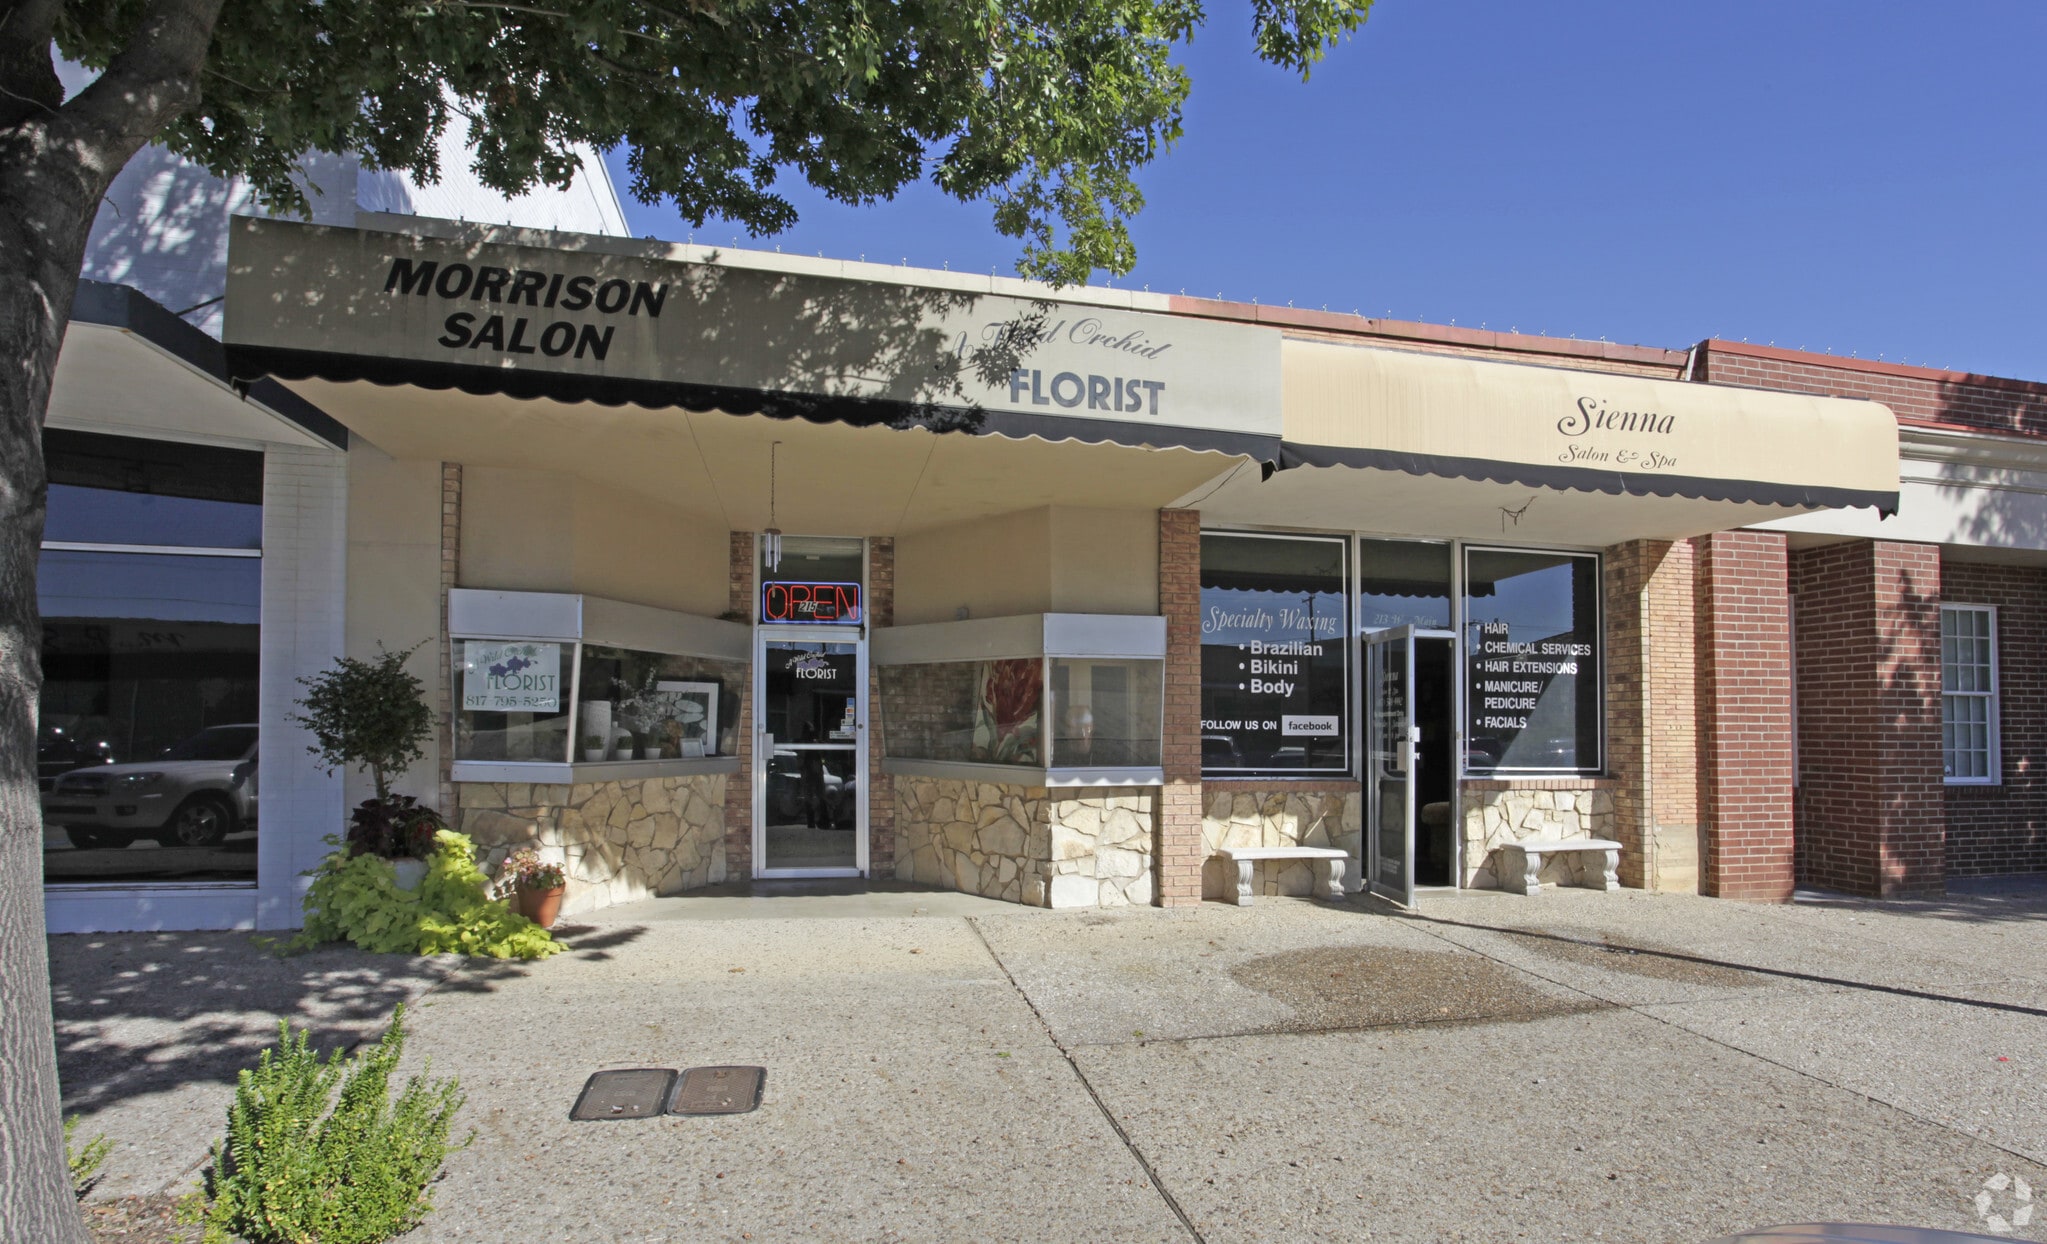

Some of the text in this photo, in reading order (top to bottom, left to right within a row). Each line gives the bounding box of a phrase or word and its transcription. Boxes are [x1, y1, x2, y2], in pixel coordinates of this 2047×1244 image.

[384, 258, 669, 318] MORRISON
[438, 311, 615, 361] SALON
[1068, 317, 1173, 361] Orchid
[1009, 368, 1166, 416] FLORIST
[1557, 396, 1676, 437] Sienna
[1558, 443, 1678, 470] Salon & Spa
[766, 585, 857, 620] OPEN
[798, 601, 818, 612] 215
[1201, 605, 1338, 635] Specialty Waxing
[1484, 623, 1509, 635] HAIR
[1250, 640, 1323, 657] Brazilian
[1485, 641, 1591, 656] CHEMICAL SERVICES
[796, 667, 838, 680] FLORIST
[1250, 659, 1299, 675] Bikini
[1485, 661, 1578, 675] HAIR EXTENSIONS
[487, 673, 556, 692] FLORIST
[1250, 678, 1295, 698] Body
[1484, 680, 1544, 694] MANICURE/
[1484, 697, 1537, 710] PEDICURE
[1200, 720, 1333, 731] FOLLOW US ON facebook
[1484, 716, 1528, 729] FACIALS
